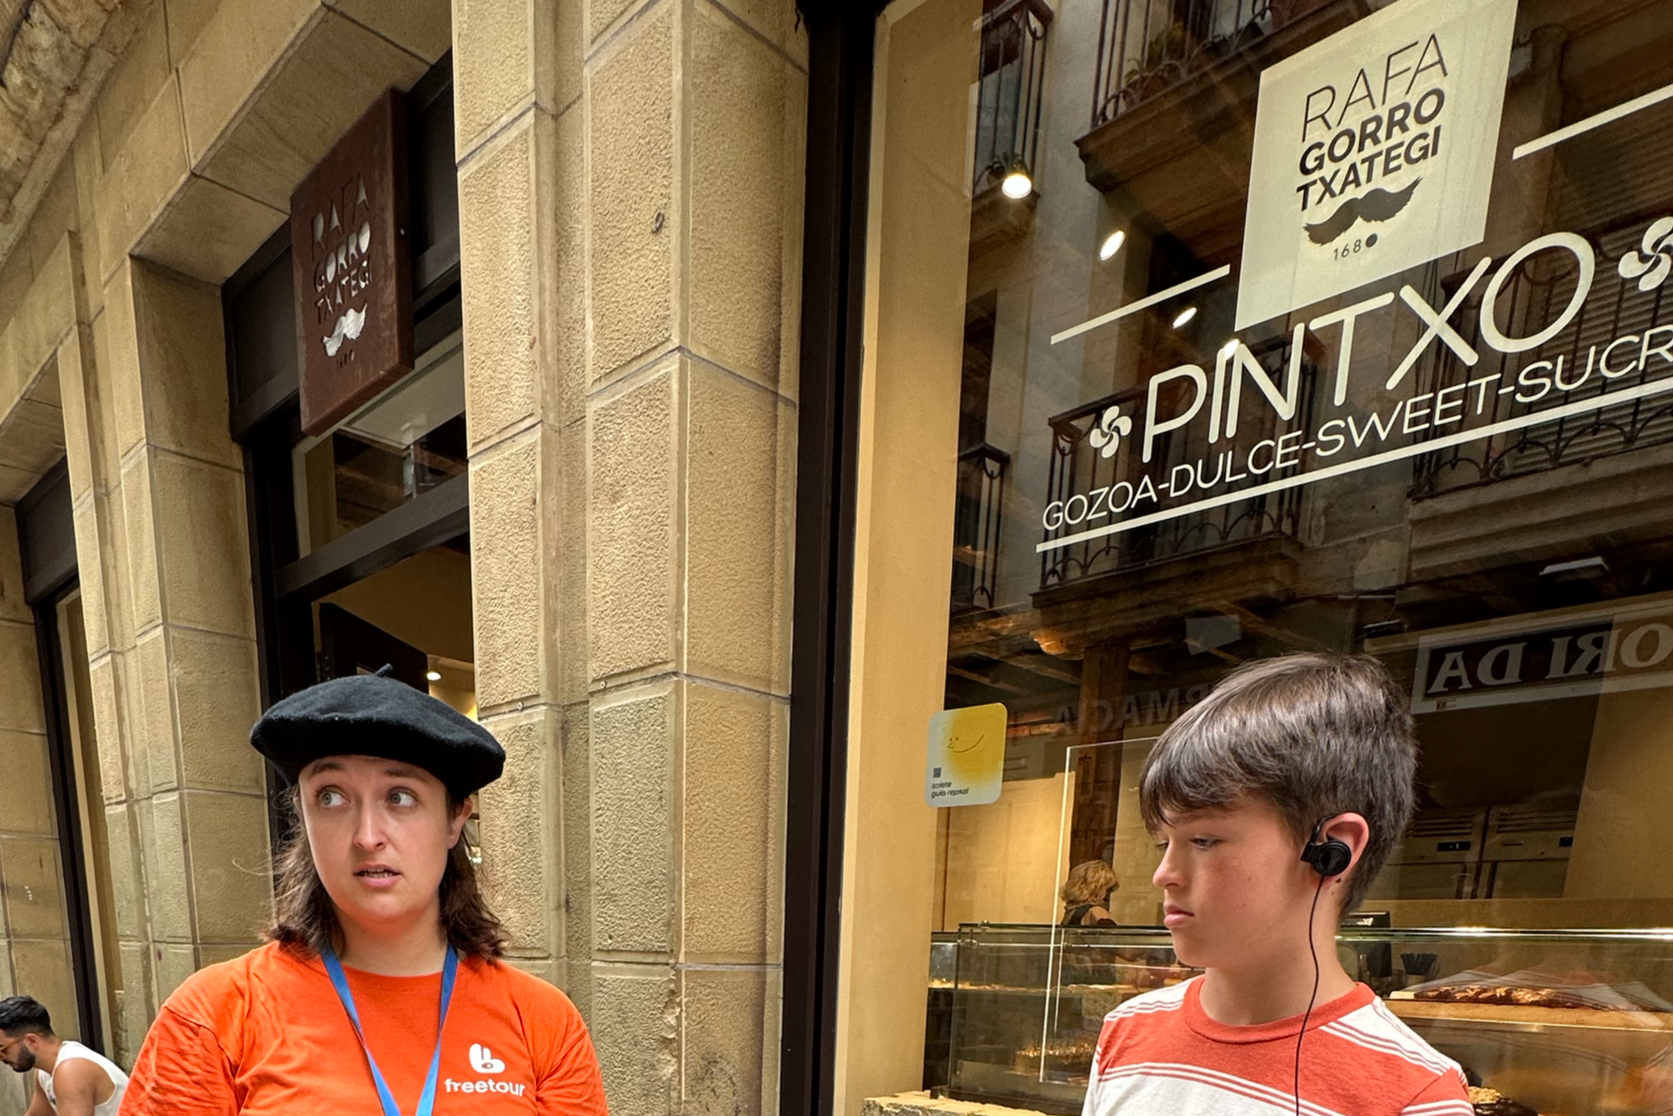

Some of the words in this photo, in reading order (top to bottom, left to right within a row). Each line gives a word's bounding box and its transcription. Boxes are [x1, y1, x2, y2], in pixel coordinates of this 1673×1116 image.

[1299, 87, 1446, 177] GORRO
[1302, 32, 1448, 144] RAFA
[1296, 124, 1442, 212] TXATEGI
[313, 220, 372, 293] GORRO
[1142, 231, 1596, 463] PINTXO
[444, 1078, 526, 1097] freetour
